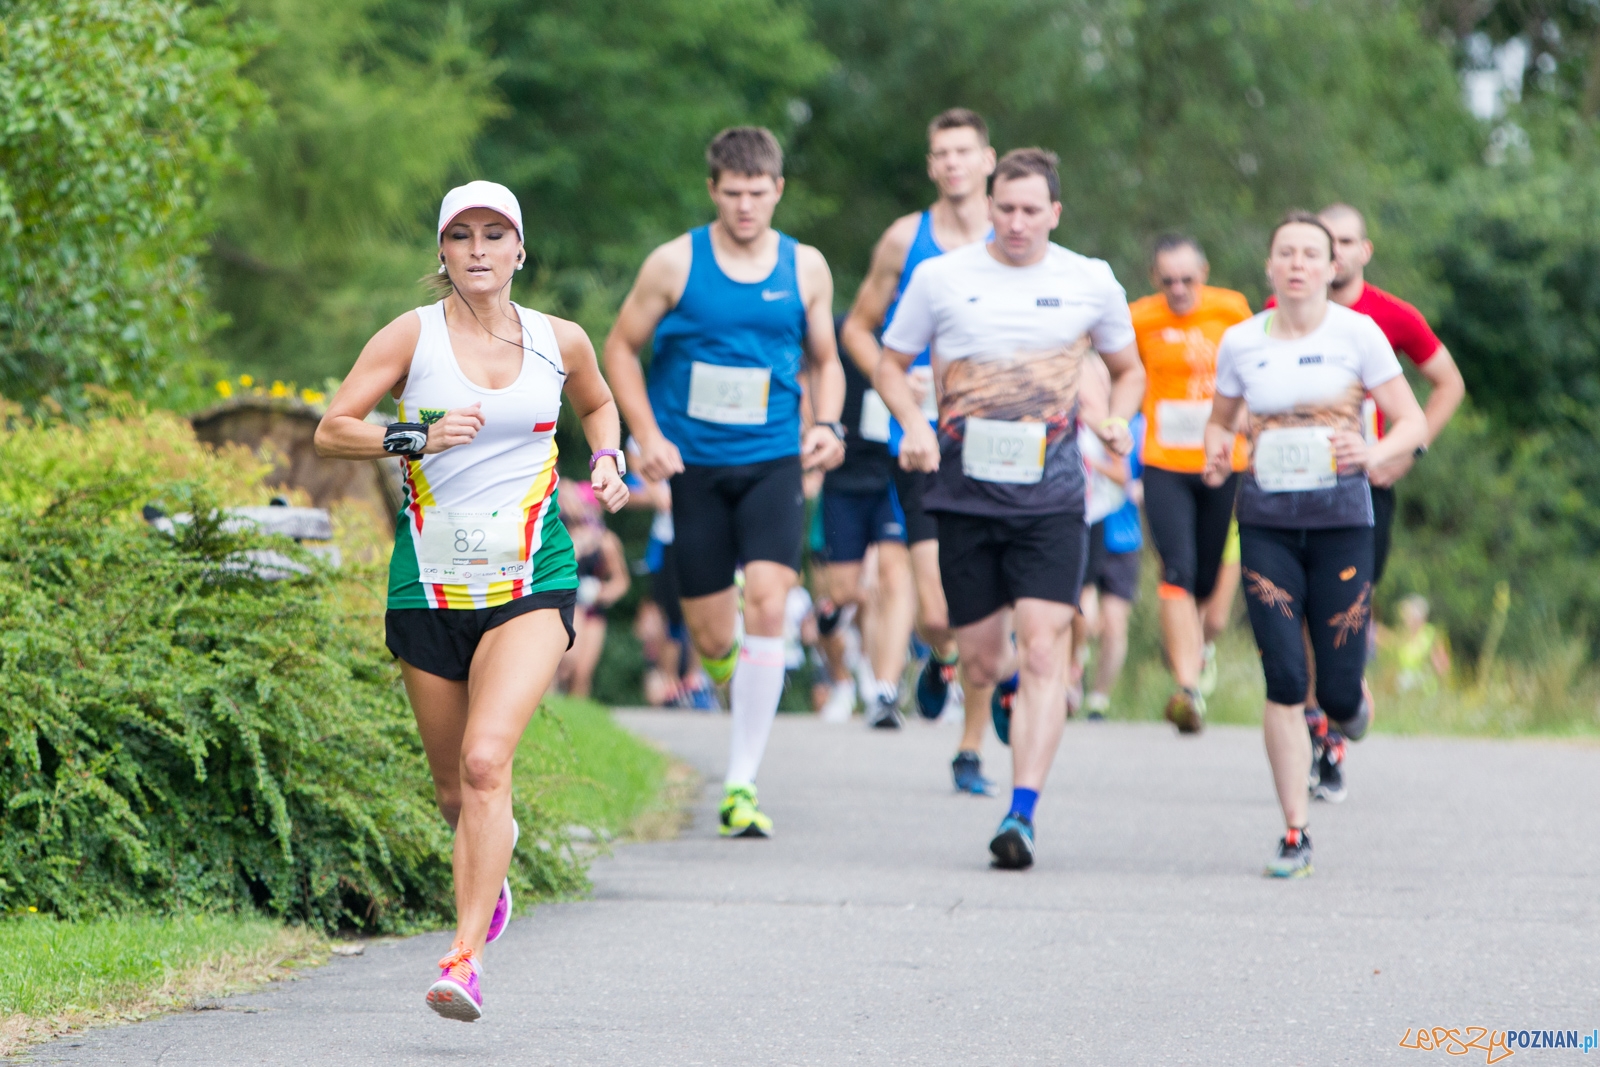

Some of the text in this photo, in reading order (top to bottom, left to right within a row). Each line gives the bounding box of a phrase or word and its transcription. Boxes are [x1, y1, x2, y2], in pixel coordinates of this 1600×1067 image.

[987, 436, 1024, 459] 102
[1276, 443, 1310, 465] 101
[453, 528, 487, 553] 82
